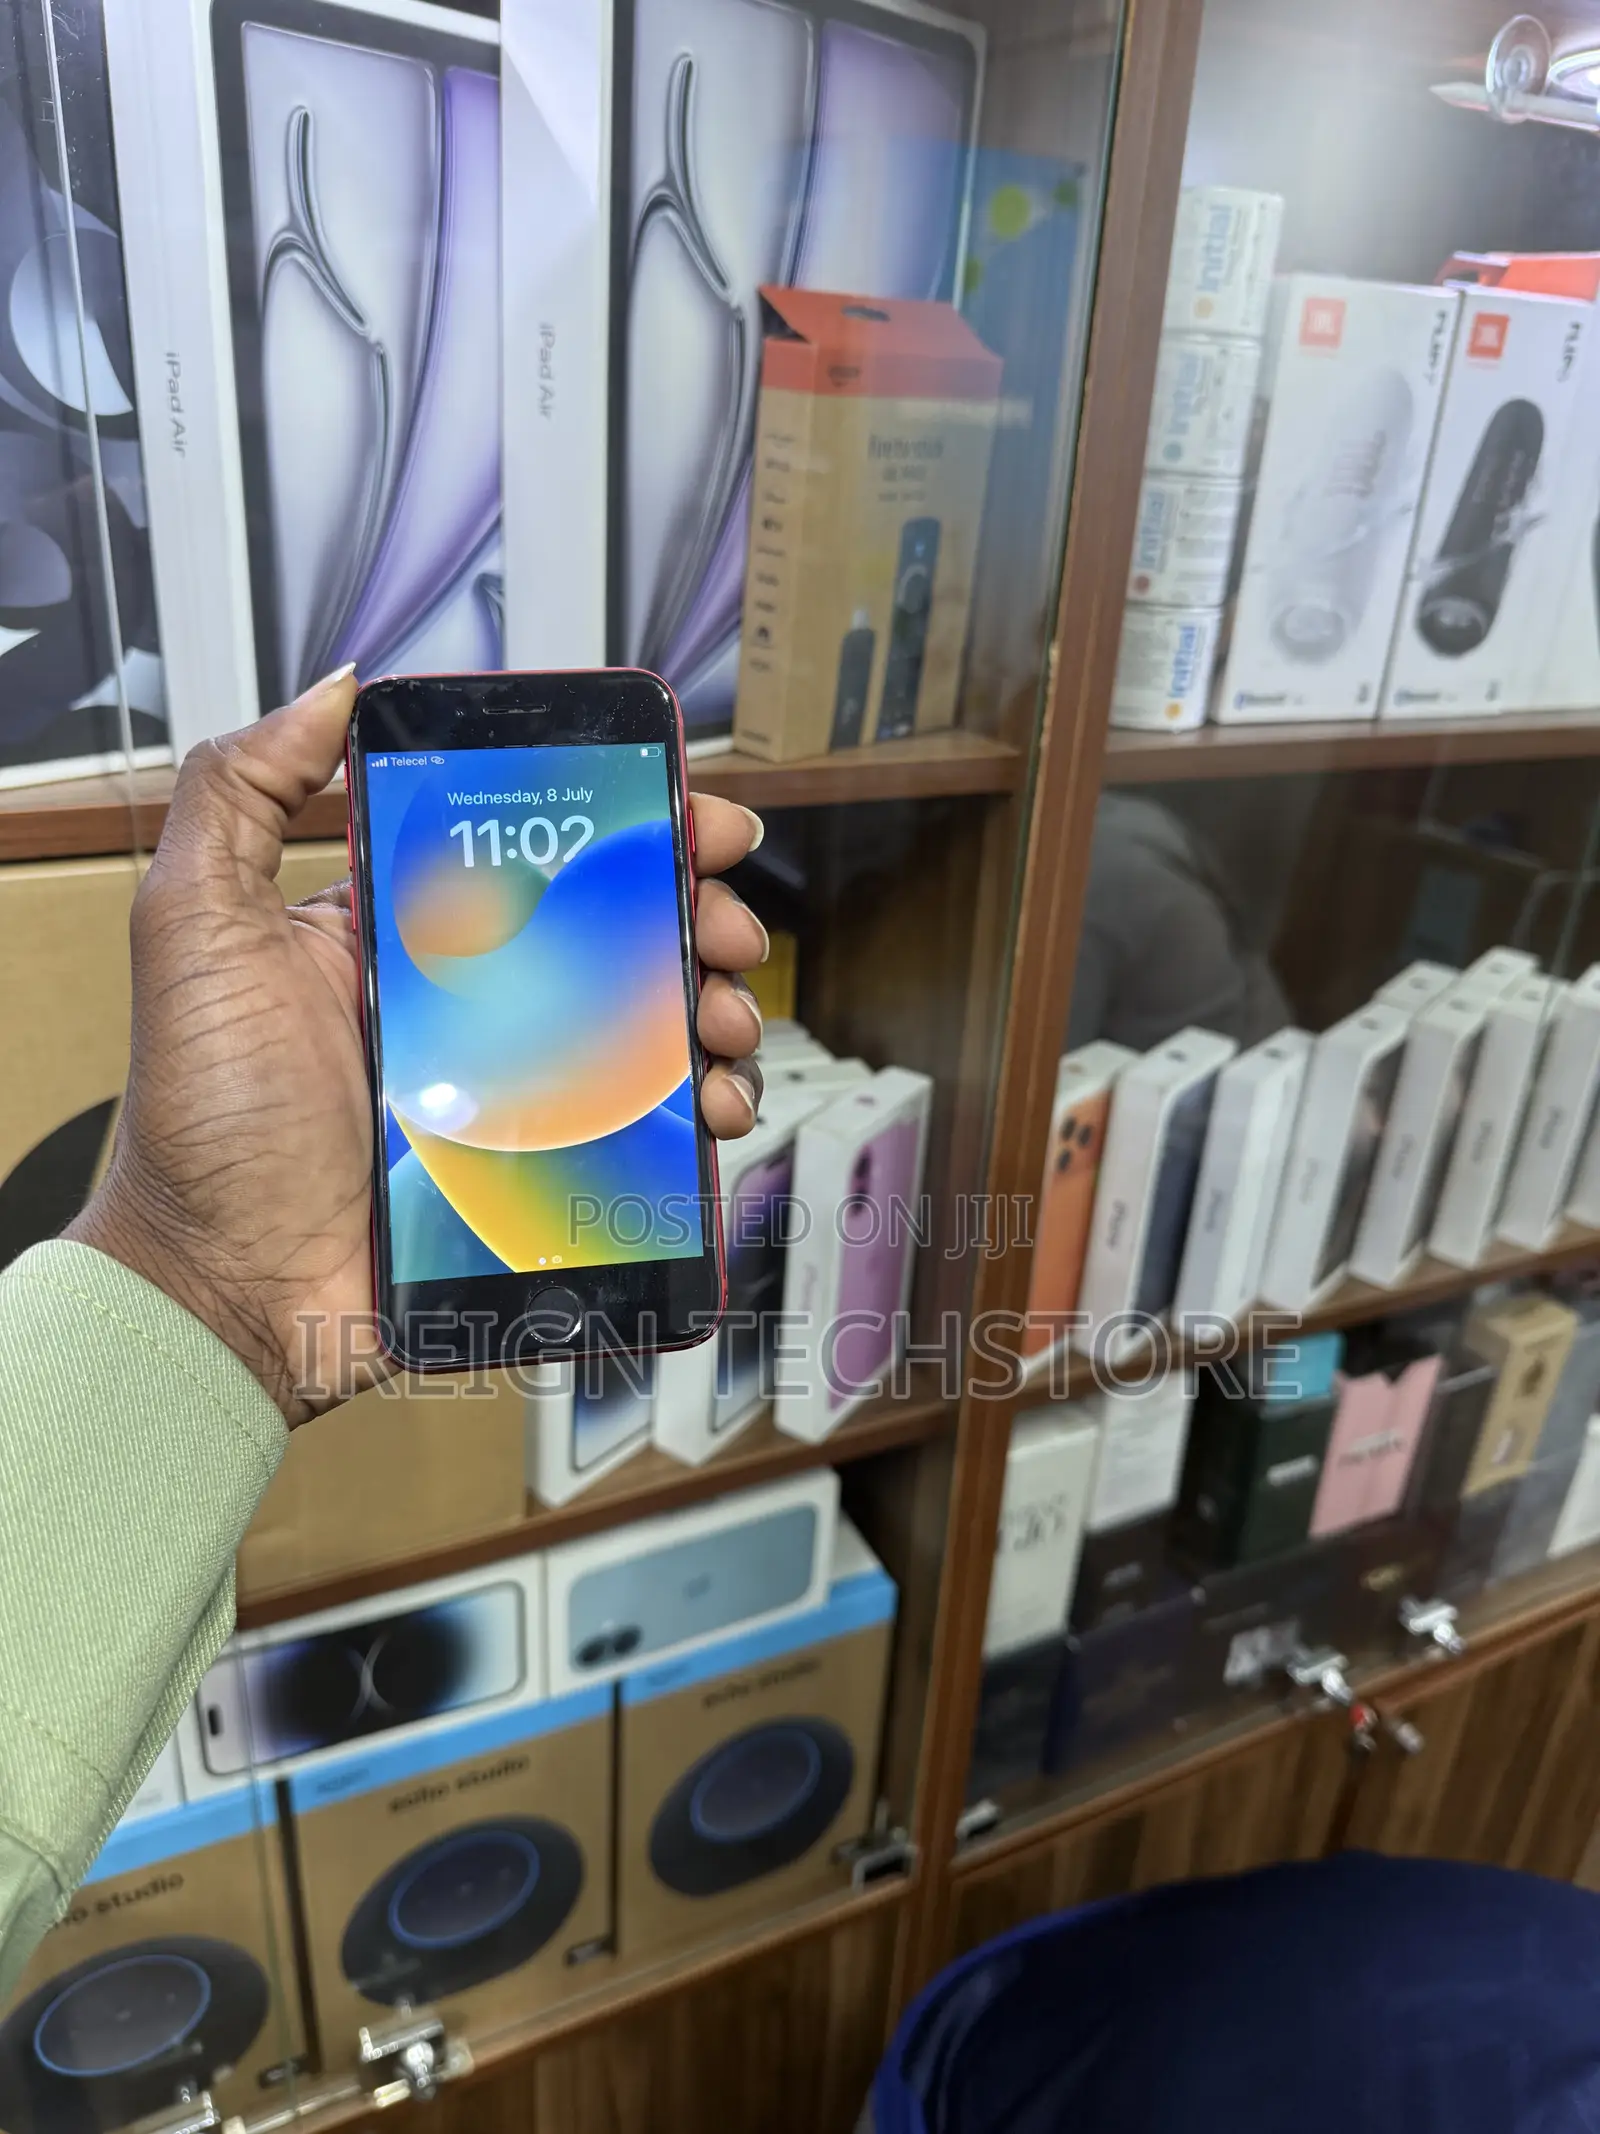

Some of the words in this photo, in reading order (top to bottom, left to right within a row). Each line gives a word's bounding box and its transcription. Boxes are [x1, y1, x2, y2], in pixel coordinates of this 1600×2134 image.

[540, 322, 556, 380] iPad
[164, 351, 184, 413] iPad
[538, 382, 556, 421] Air
[169, 416, 188, 460] Air
[390, 756, 428, 767] Telecel
[447, 789, 543, 806] Wednesday,
[546, 788, 558, 802] 8
[561, 787, 594, 803] July
[450, 815, 595, 868] 11:02
